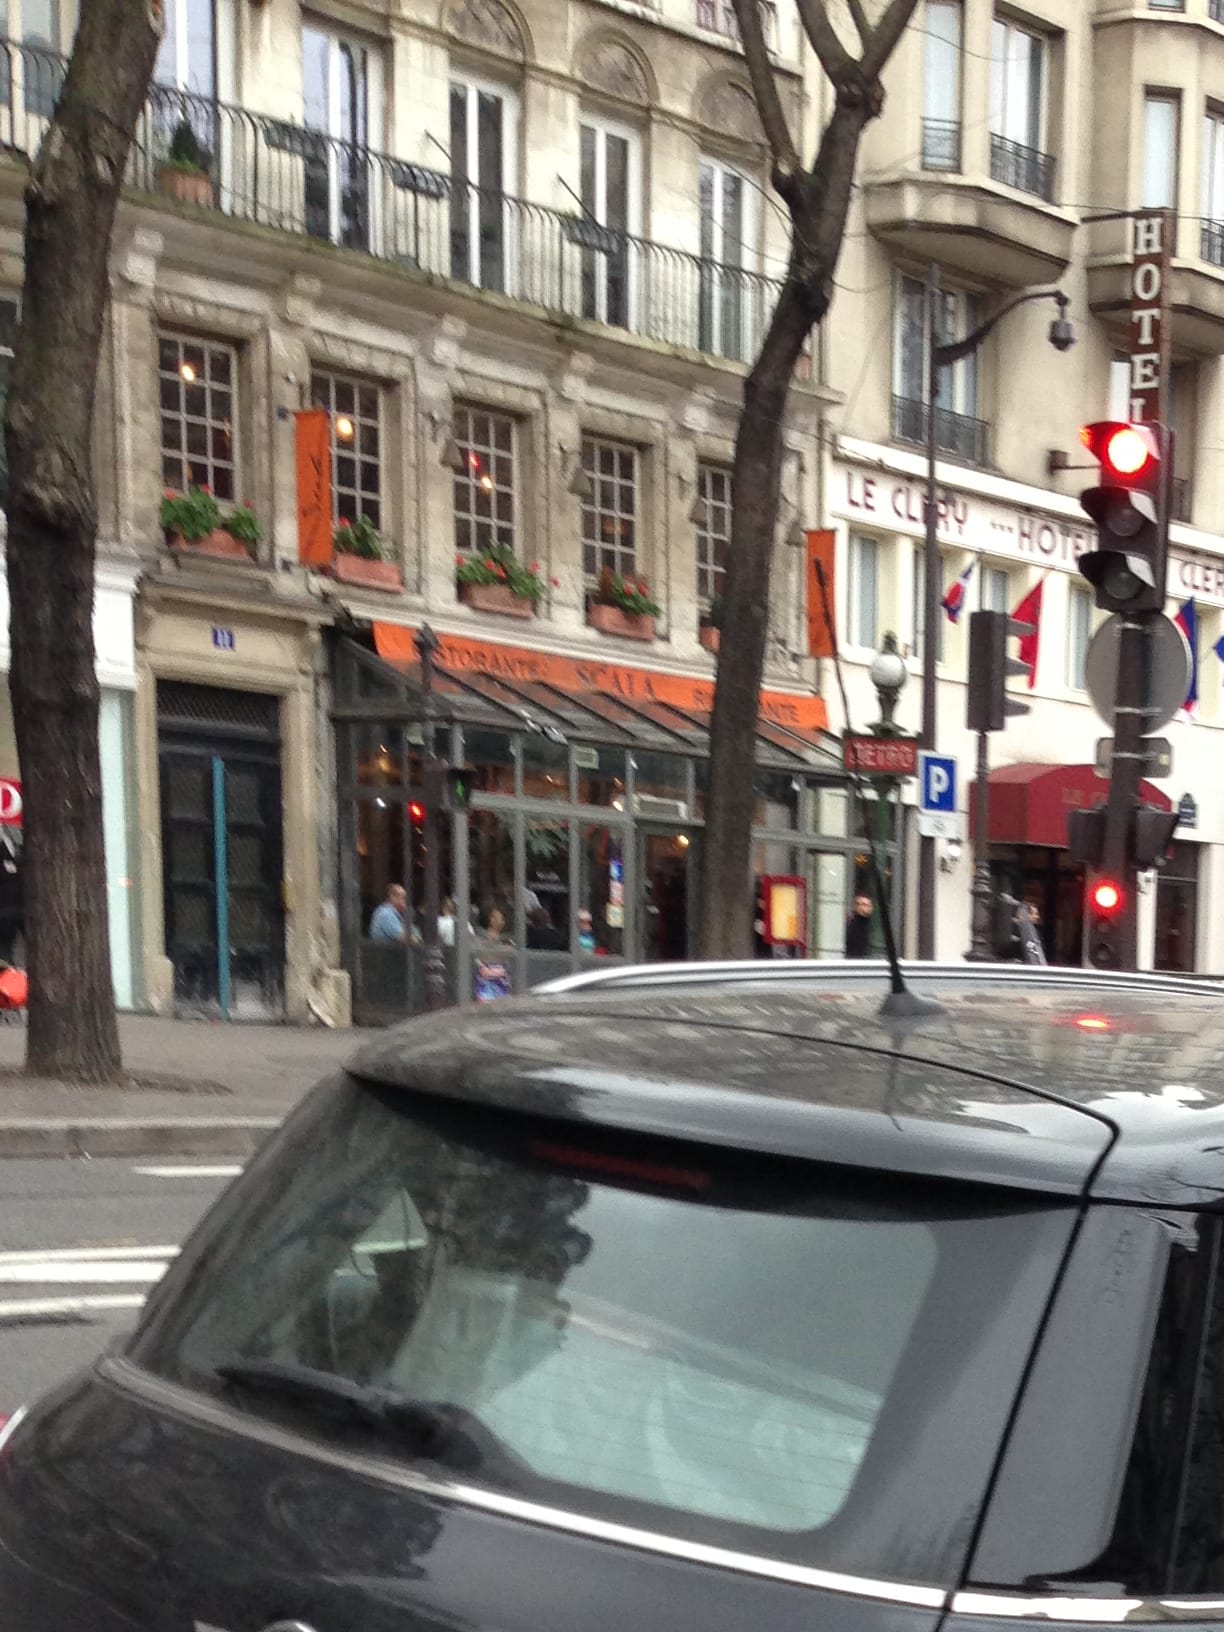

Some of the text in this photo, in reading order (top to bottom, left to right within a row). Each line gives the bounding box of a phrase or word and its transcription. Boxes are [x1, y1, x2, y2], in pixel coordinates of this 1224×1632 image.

[847, 472, 876, 512] LE
[891, 486, 968, 536] CLRY
[929, 766, 950, 803] P
